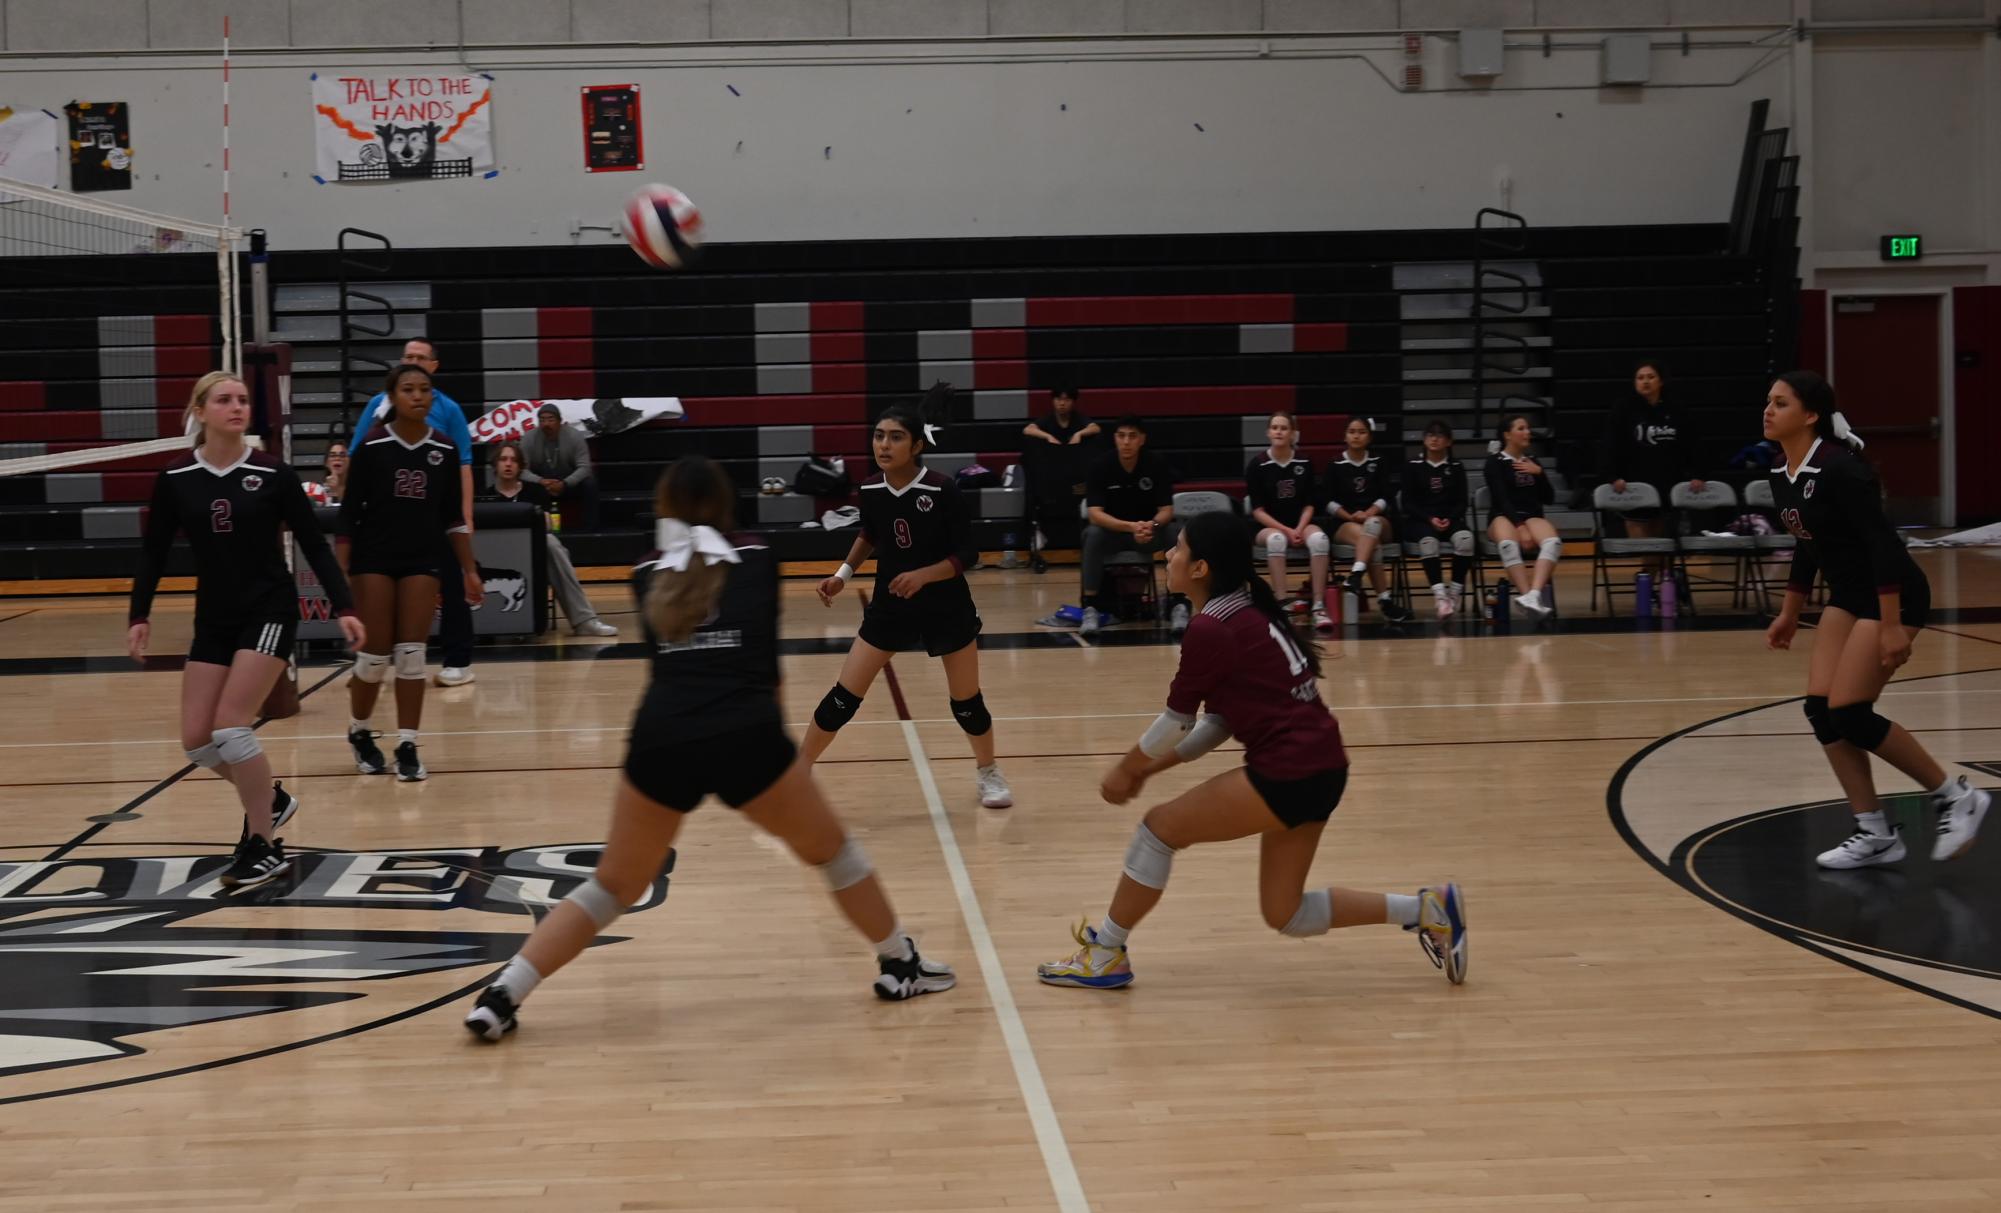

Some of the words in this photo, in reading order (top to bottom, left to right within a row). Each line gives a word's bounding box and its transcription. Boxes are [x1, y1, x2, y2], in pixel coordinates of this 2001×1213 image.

[338, 78, 404, 104] TALK
[406, 78, 433, 97] TO
[438, 78, 473, 95] THE
[372, 101, 455, 122] HANDS
[1890, 237, 1919, 257] EXIT
[394, 468, 428, 500] 22
[210, 498, 233, 534] 2
[893, 518, 912, 549] 9
